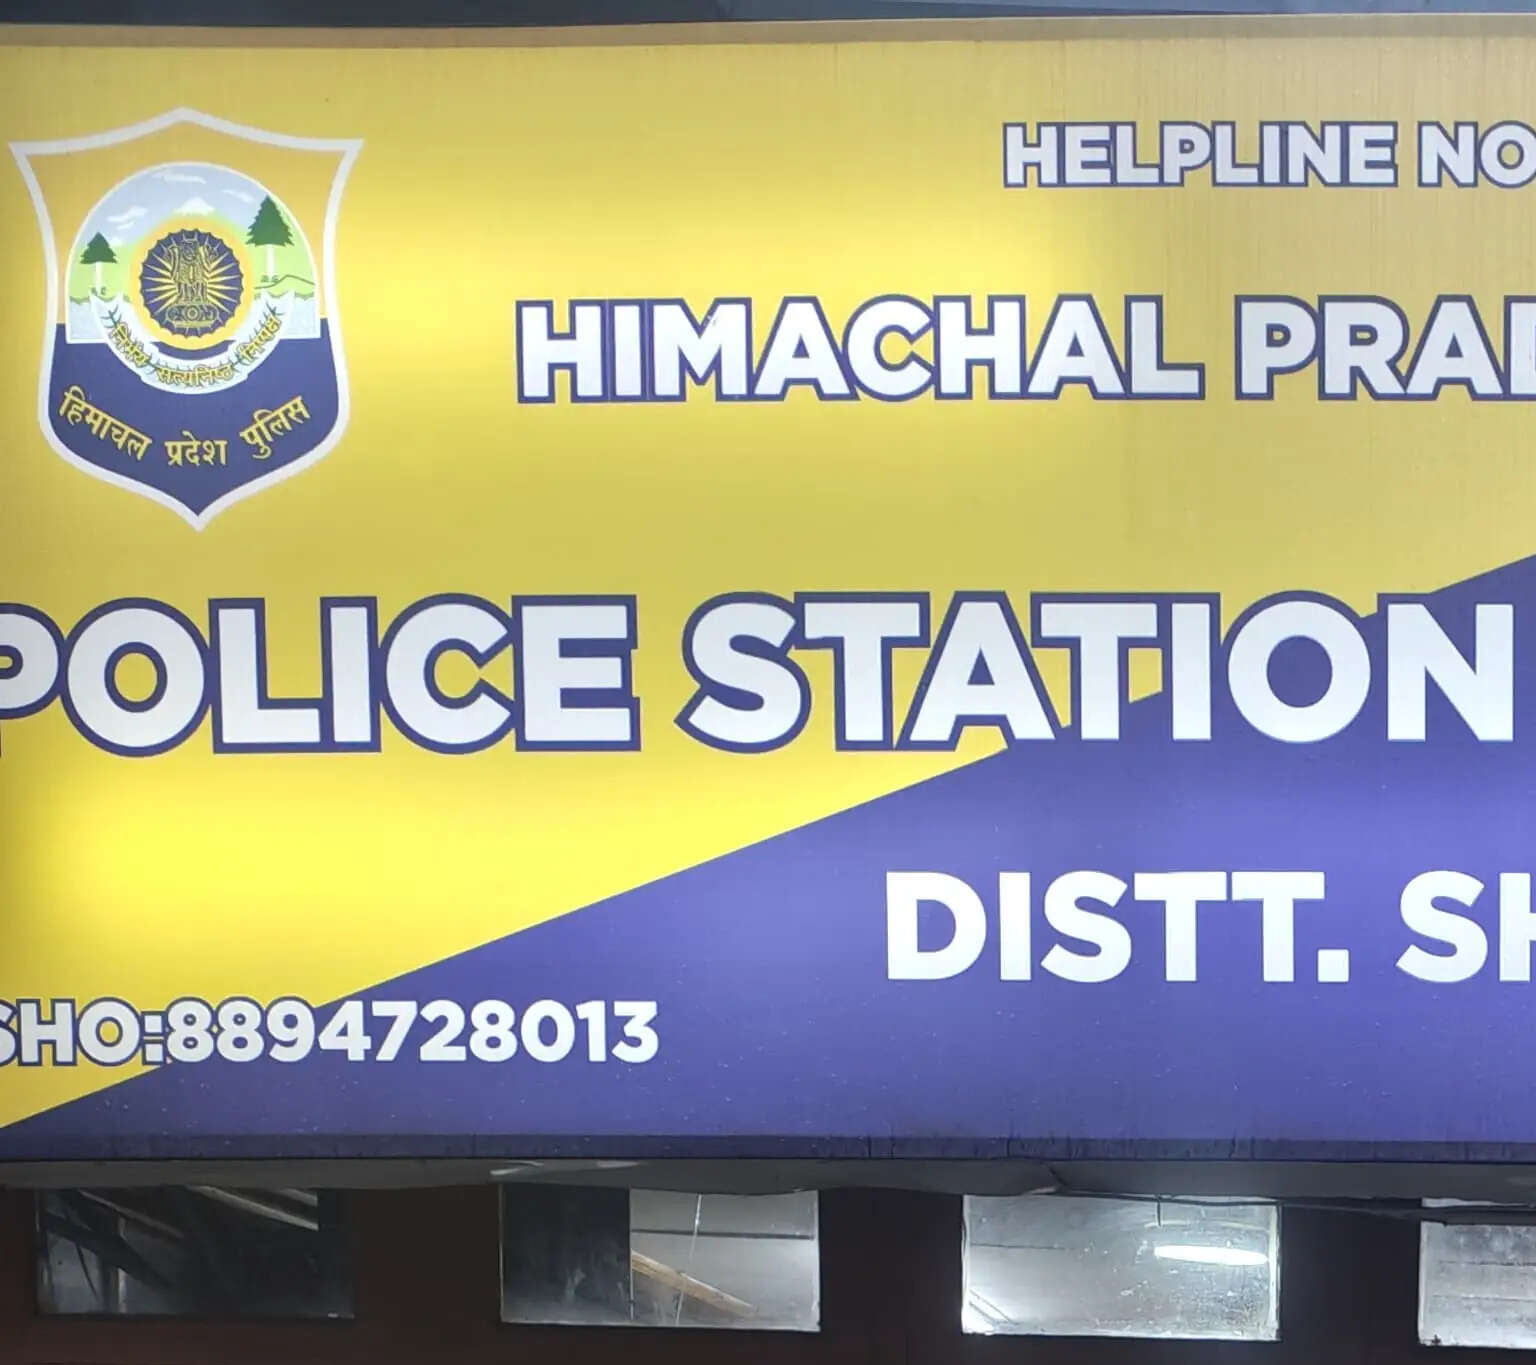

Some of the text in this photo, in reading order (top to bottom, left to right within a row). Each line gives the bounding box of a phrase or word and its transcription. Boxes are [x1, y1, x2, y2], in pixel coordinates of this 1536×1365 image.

[1003, 120, 1398, 188] HELPLINE
[516, 293, 1204, 403] HIMACHAL
[59, 385, 311, 466] हिमाचल प्रदेश पुलिस
[675, 591, 1514, 754] STATION
[885, 869, 1349, 984] DISTT.
